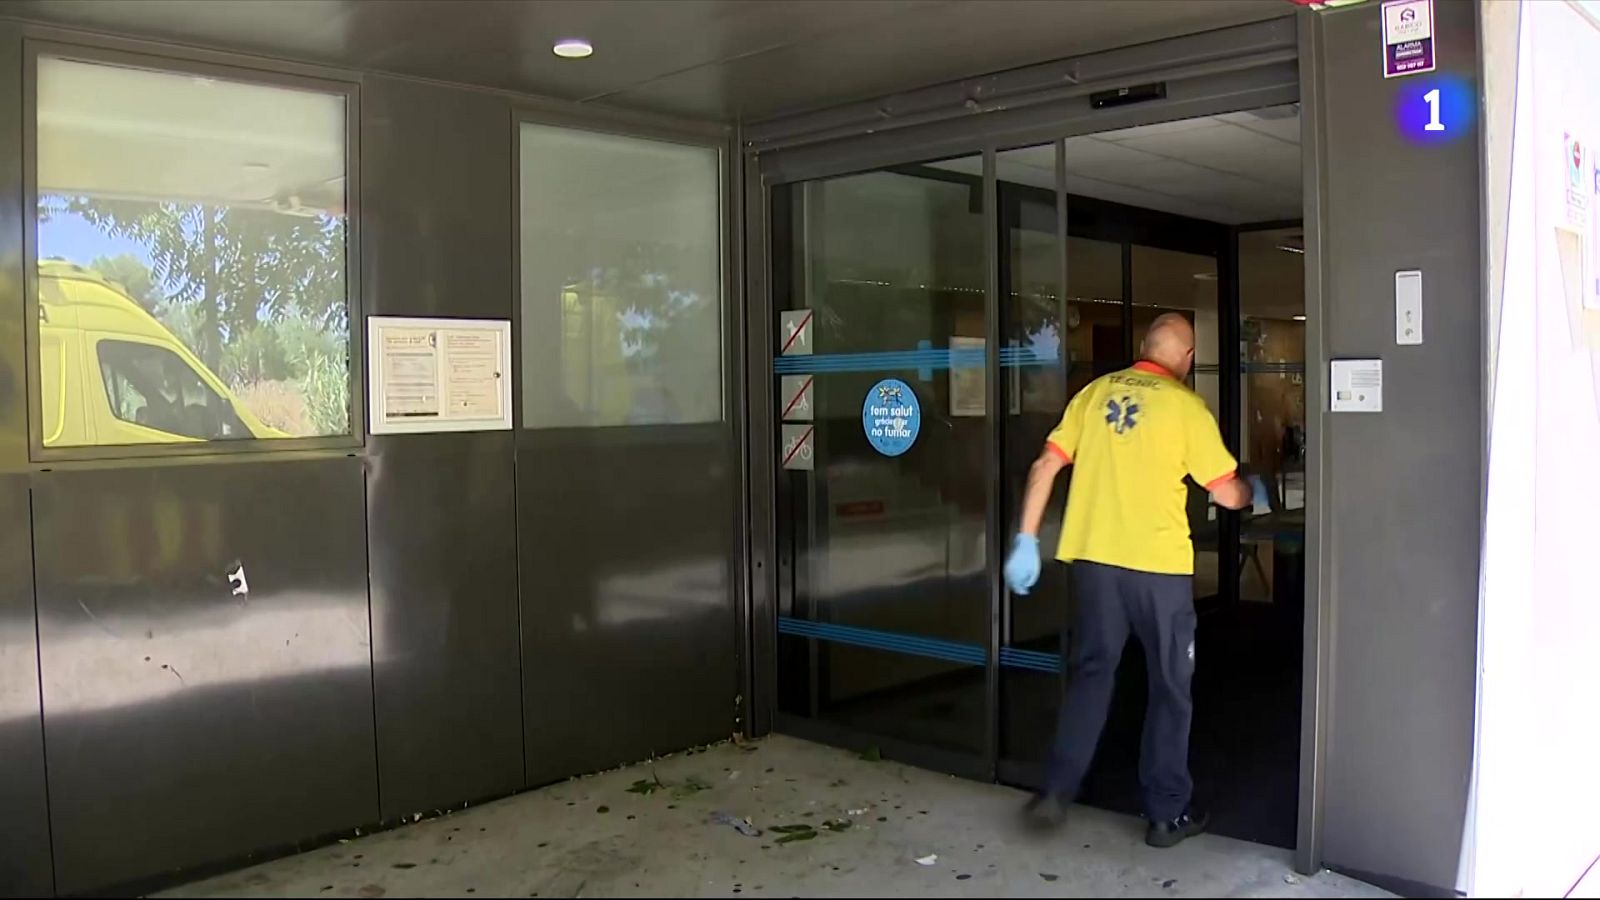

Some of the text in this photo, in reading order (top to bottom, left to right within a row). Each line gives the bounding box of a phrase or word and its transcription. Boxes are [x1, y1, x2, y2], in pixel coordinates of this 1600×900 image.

[870, 404, 913, 416] fem salut
[871, 426, 912, 438] no fumar
